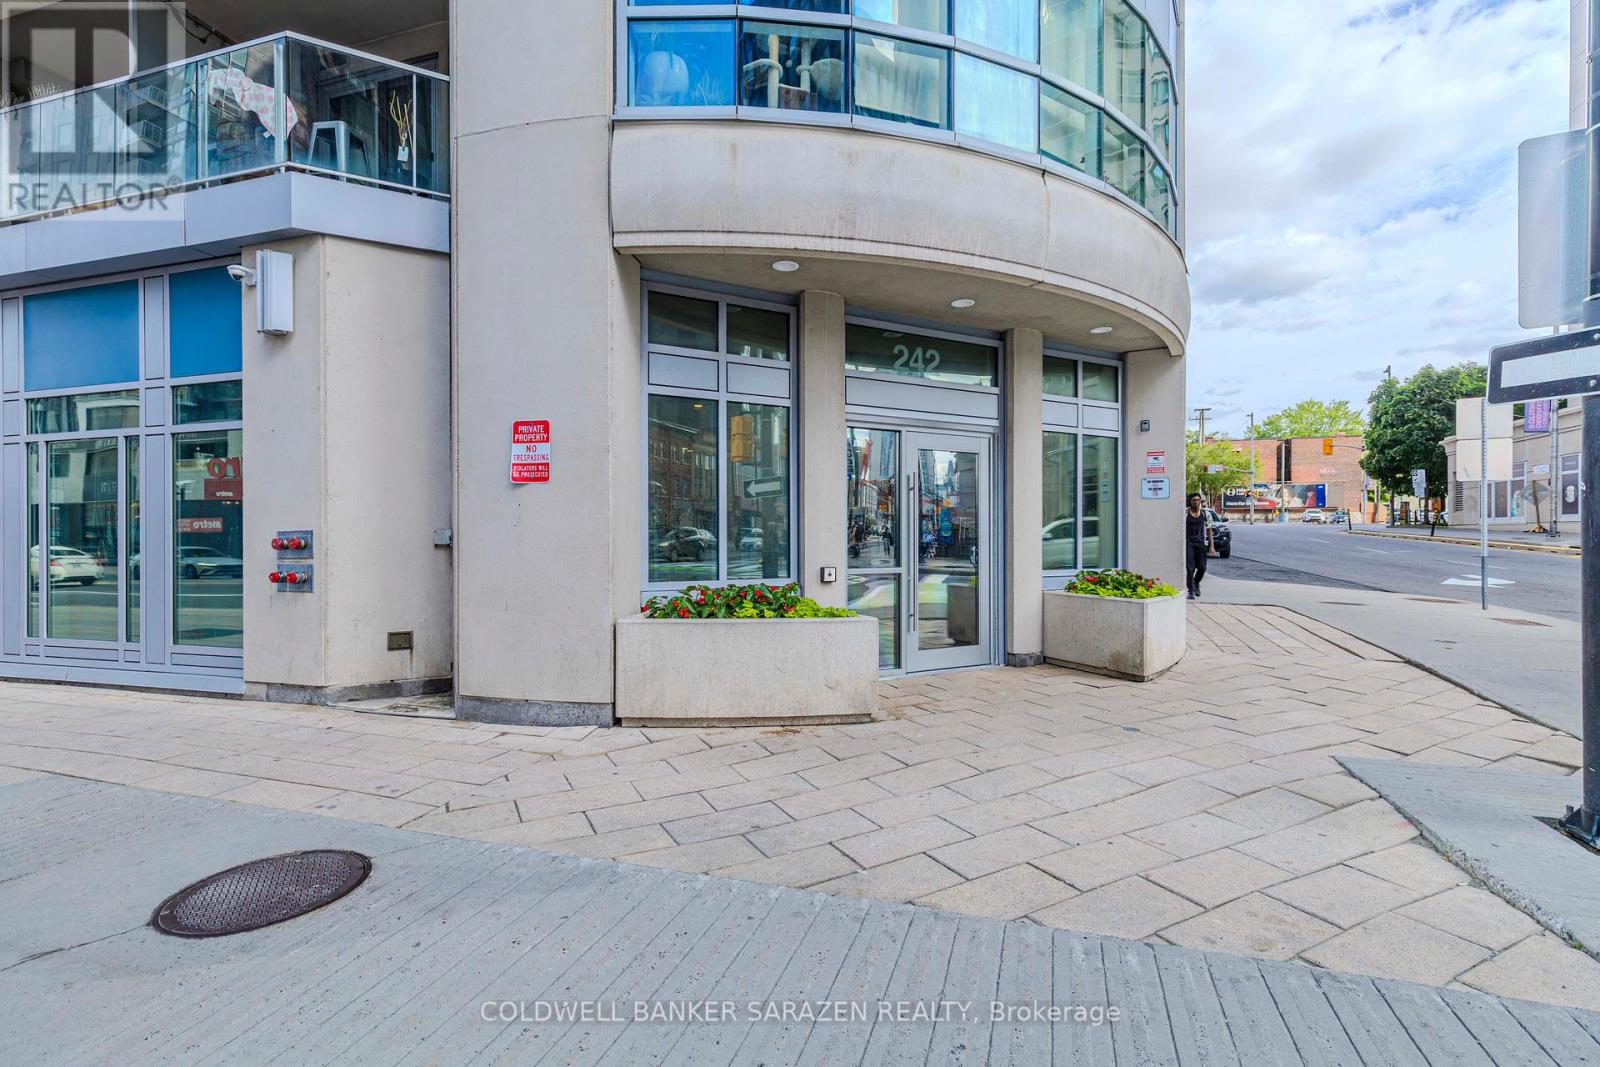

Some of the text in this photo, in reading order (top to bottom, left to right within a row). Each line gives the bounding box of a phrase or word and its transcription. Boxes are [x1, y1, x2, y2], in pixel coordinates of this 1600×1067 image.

[893, 344, 940, 373] 242
[518, 425, 545, 433] PRIVATE
[514, 433, 548, 442] PROPERTY
[526, 445, 537, 453] NO
[513, 453, 549, 462] TRESPASSING
